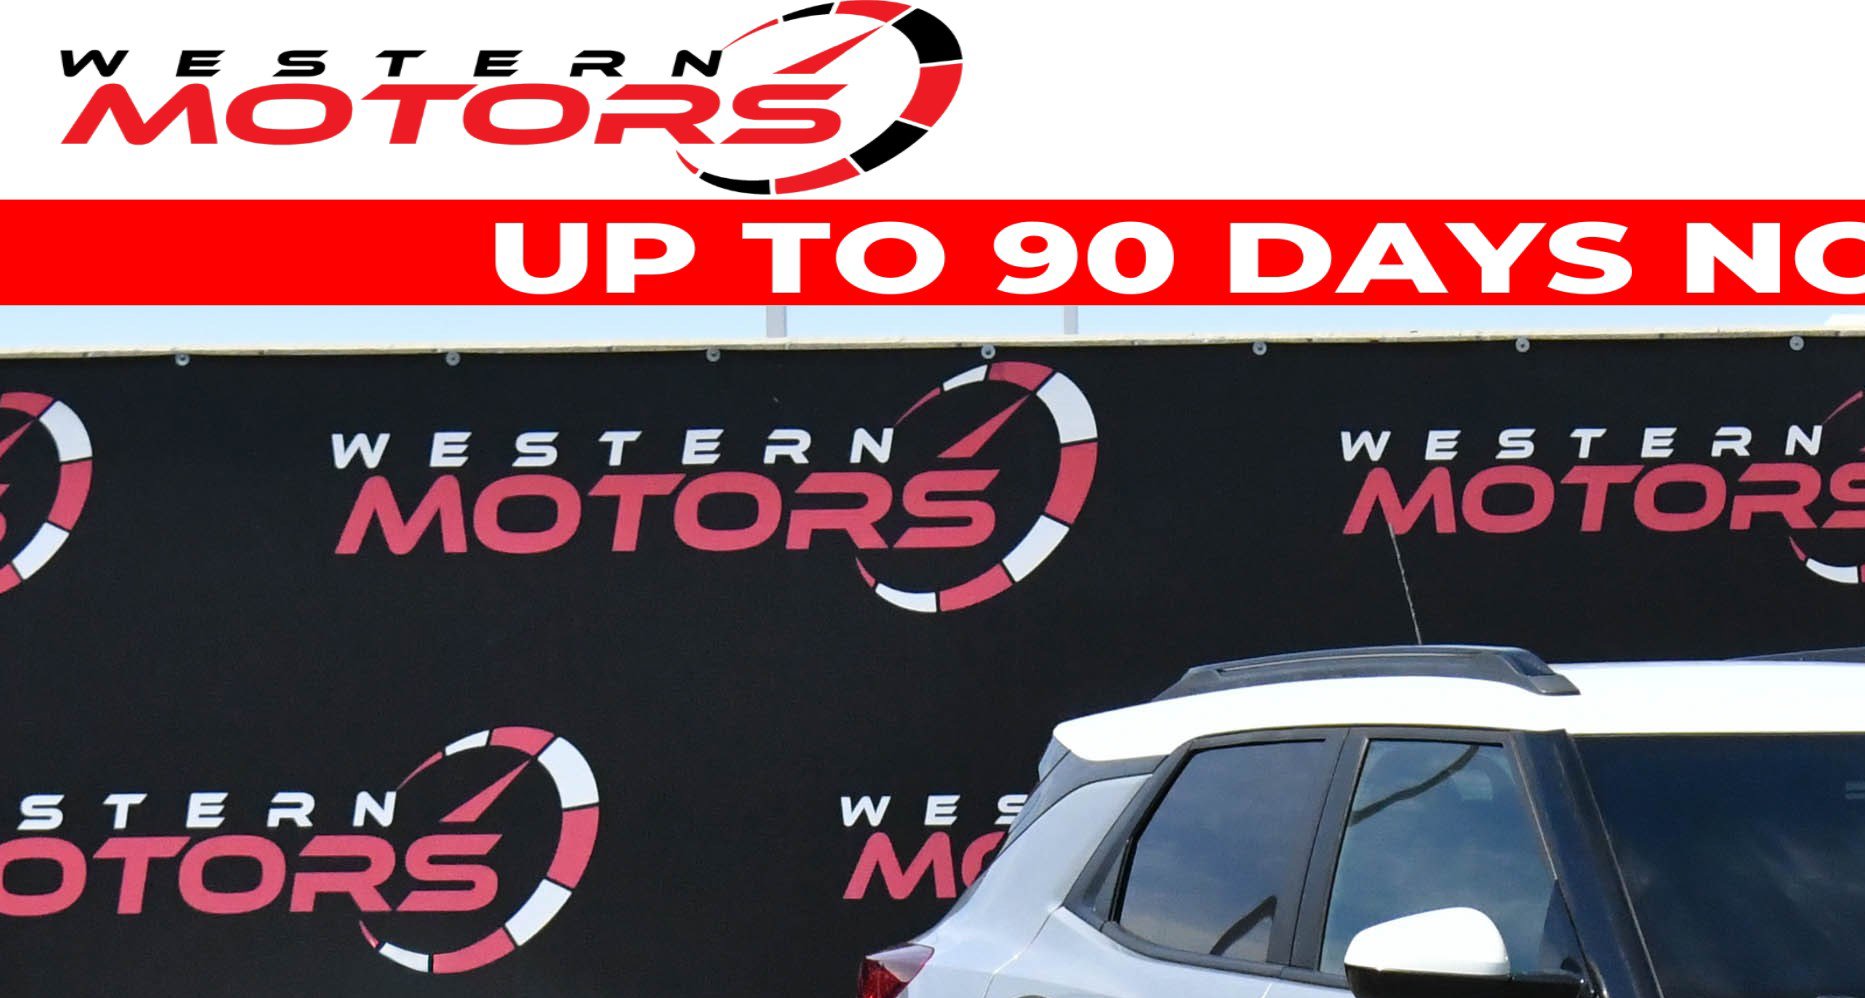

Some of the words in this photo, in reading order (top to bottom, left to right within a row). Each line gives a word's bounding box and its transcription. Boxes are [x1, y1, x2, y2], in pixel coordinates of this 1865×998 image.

[332, 427, 894, 469] WESTERN
[1342, 425, 1822, 462] WESTERN
[335, 470, 999, 555] MOTORS
